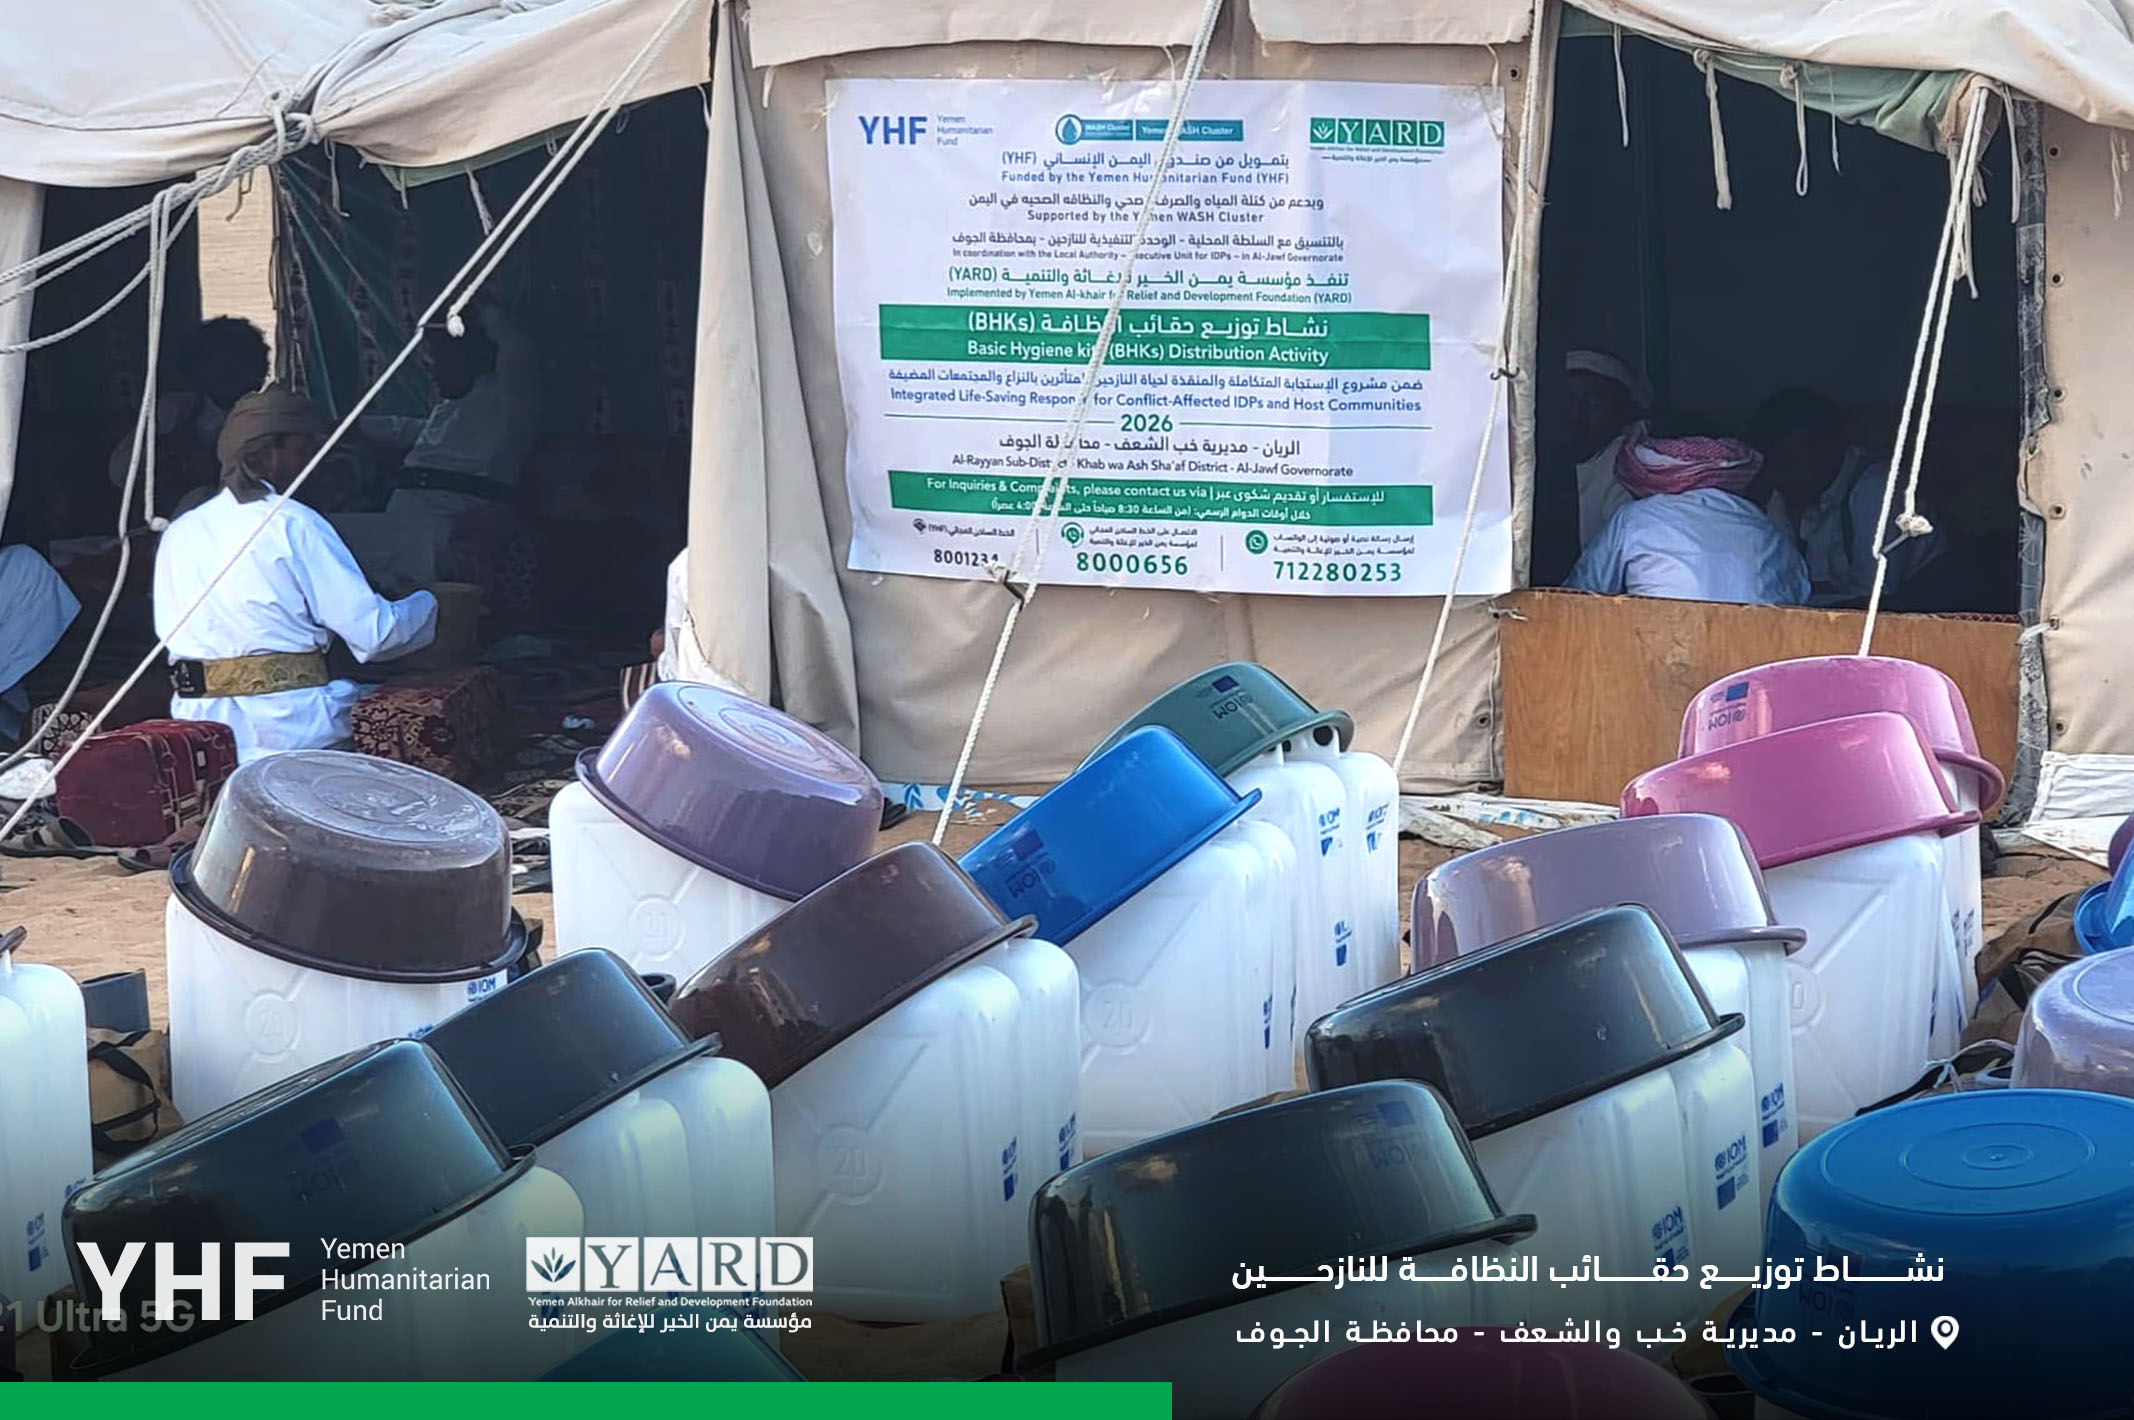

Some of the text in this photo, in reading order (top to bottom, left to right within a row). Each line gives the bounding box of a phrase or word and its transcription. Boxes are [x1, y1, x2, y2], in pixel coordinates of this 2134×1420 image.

[858, 116, 928, 145] YHF
[1338, 119, 1445, 147] YARD
[1002, 151, 1289, 169] بتمويل من اليمن الإنساني (YHF)
[1002, 171, 1289, 184] Funded by the Yemen Huanitarian Fund (YHF)
[970, 192, 1324, 210] وبدعم المياه اليمن
[1028, 210, 1264, 222] Supported by the WASH Cluster
[952, 232, 1344, 250] بالتنسيق السلطة المحلية للنازحين بمحافظة الجوف
[963, 249, 1344, 262] coordination with the Local Authority Unit IDPs Al-Jawf Governorate
[949, 266, 1348, 290] تنفذ مؤسسة يمن الخير والتنمية (YARD)
[947, 287, 1352, 304] Implemented by Yemen Al-khair Relief and Development Foundation (YARD)
[968, 312, 1328, 340] نشاط توزيع حقائب (BHKs)
[968, 340, 1328, 366] Basic Hygiene (BHKs) Distribution Activity
[888, 368, 1422, 394] ضمن مشروع الإستجابة المتكاملة والمنقذة لحياة بالنزاع والمجتمعات المضيفة
[891, 388, 1421, 412] Integrated Life-Saving for Conflict-Affected IDPs and Host Communities
[1120, 414, 1173, 432] 2026
[1000, 434, 1300, 458] الريان مديرية خب الشعف الجوف
[952, 455, 1353, 477] Al-Rayyan Khab wa Ash Sha'af District Al-Jawf Governorate
[927, 478, 1207, 498] For Inquiries please contact us via
[1234, 489, 1384, 506] للإستفسار تقديم شكوى
[1118, 504, 1288, 520] أوقات الدوام 8:30
[1076, 552, 1188, 575] 8000656
[1274, 562, 1401, 582] 712280253
